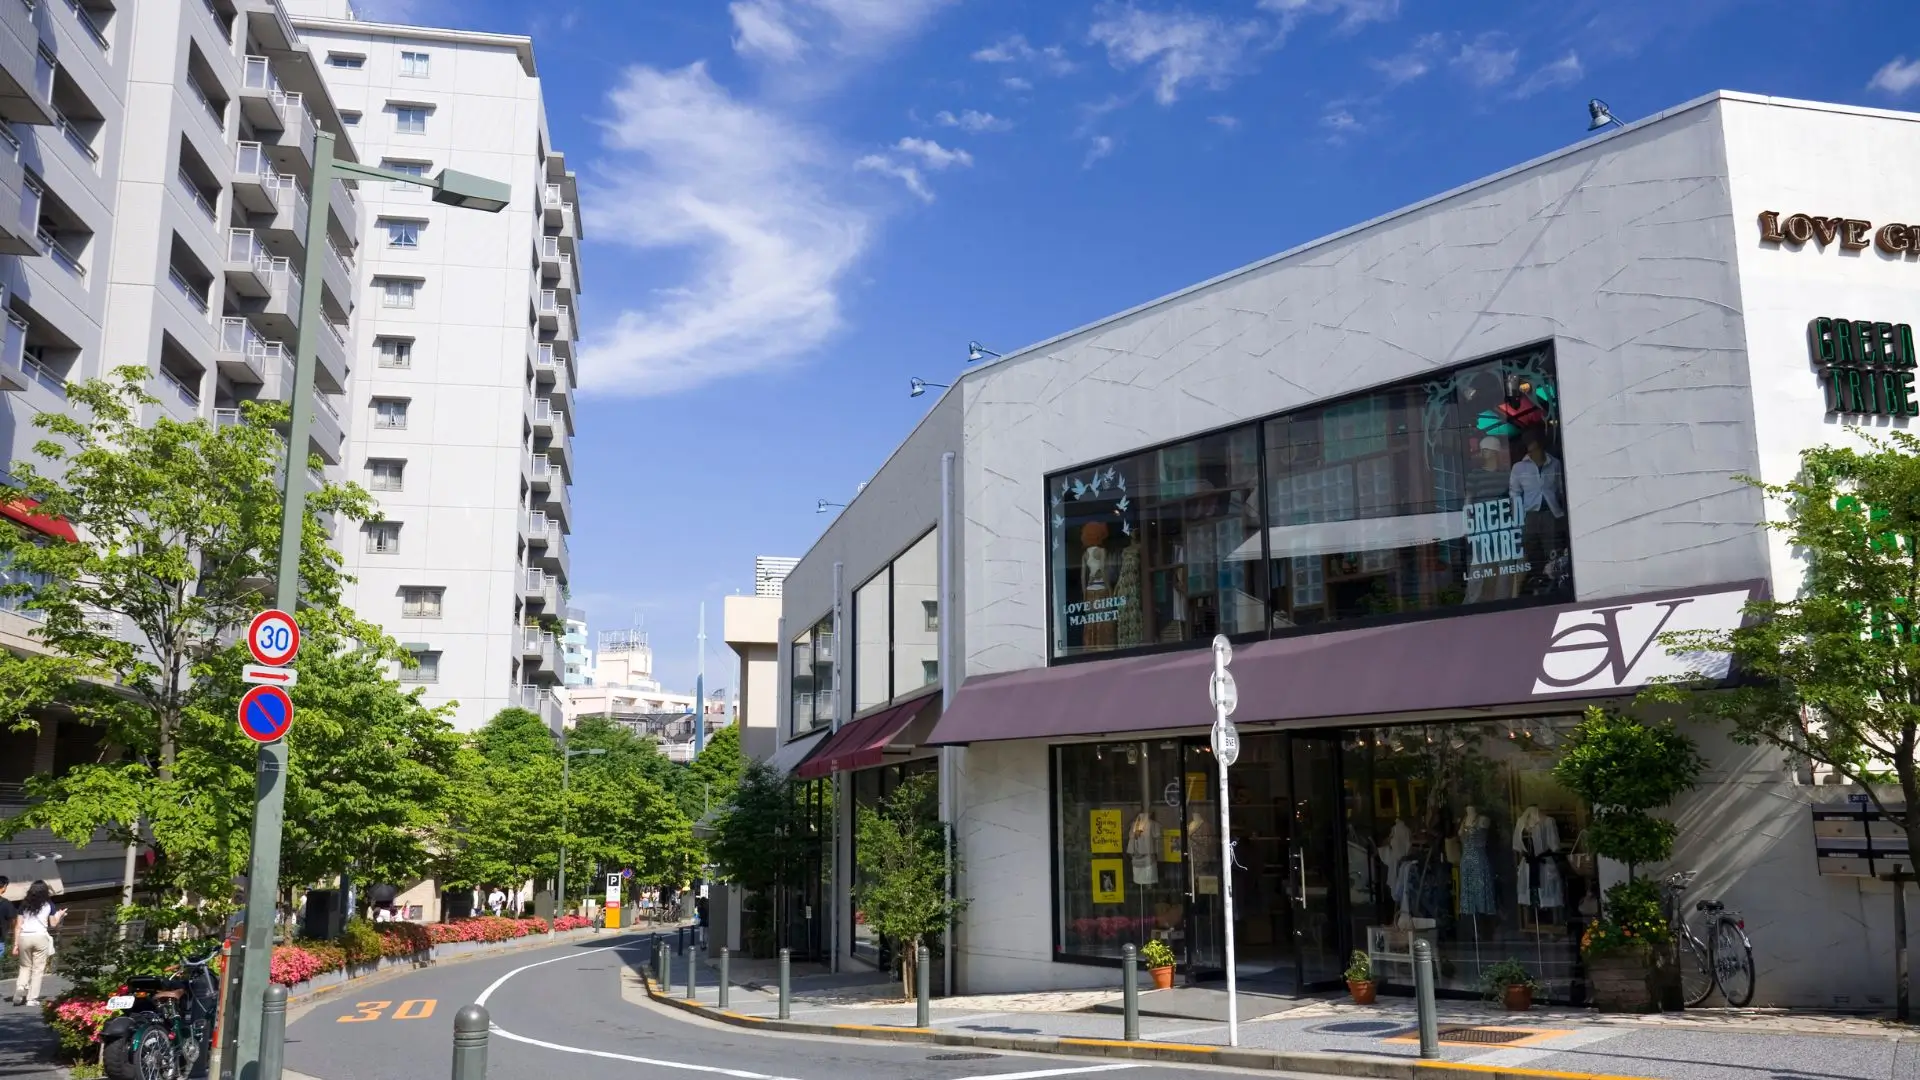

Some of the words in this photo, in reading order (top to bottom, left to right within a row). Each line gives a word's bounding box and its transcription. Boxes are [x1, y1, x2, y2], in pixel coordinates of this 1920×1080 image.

[1758, 211, 1872, 249] LOVE
[1808, 317, 1918, 370] GREEN
[1819, 366, 1919, 417] TRIBE
[1462, 496, 1525, 535] GREEN
[1468, 529, 1524, 566] TRIBE
[1500, 562, 1532, 575] MENS
[1063, 602, 1091, 615] LOVE
[1093, 596, 1127, 609] GIRLS
[1070, 610, 1119, 626] MARKET
[261, 625, 289, 651] 30
[610, 876, 617, 885] P
[336, 999, 438, 1022] 30
